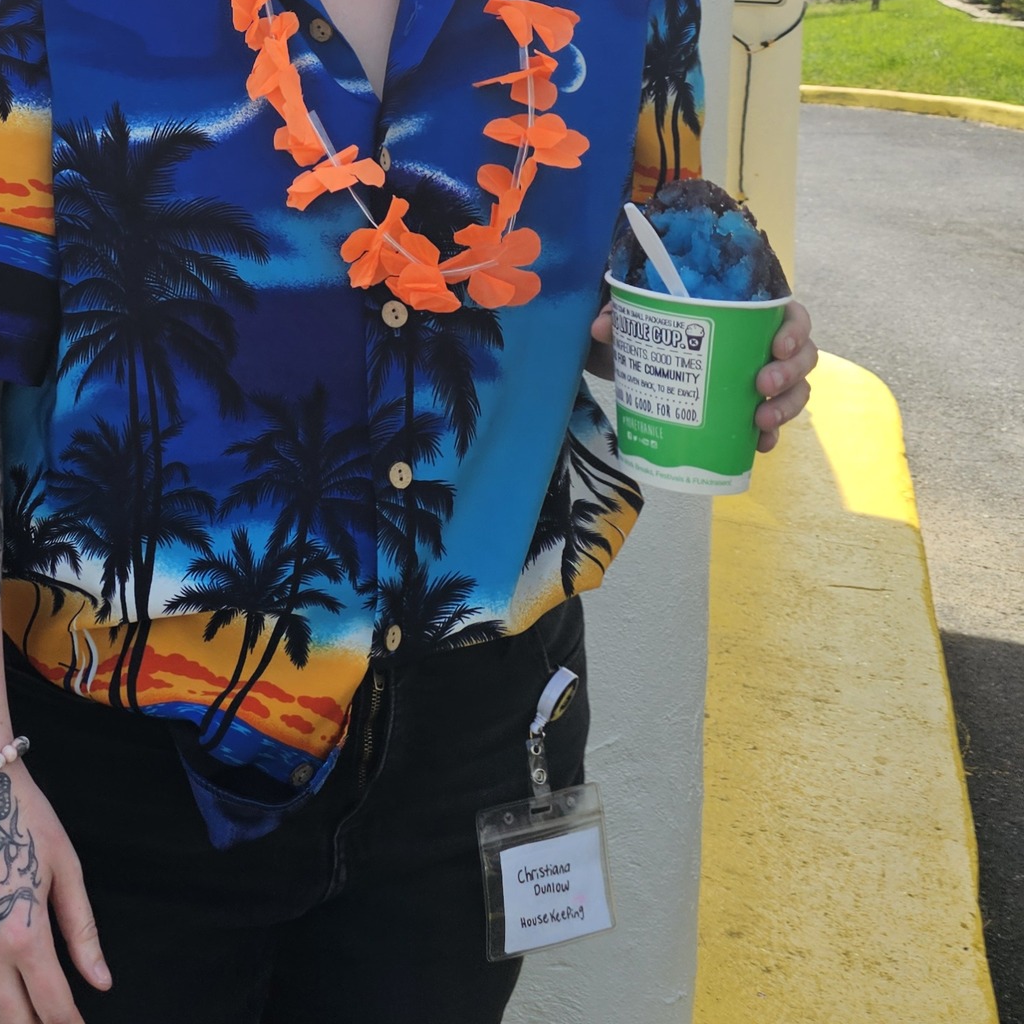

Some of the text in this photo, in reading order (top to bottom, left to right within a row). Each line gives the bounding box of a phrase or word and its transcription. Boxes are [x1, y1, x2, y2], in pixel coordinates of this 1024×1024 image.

[645, 314, 673, 328] PACKAGES
[673, 320, 686, 330] LIKE
[652, 325, 686, 350] CUP.
[629, 358, 642, 373] THE
[645, 364, 701, 384] COMMUNITY
[651, 351, 672, 366] GOOD
[675, 356, 703, 372] TIMES.
[658, 384, 665, 392] TO
[667, 386, 675, 395] BE
[657, 403, 671, 418] FOR
[675, 408, 700, 423] GOOD.
[517, 862, 571, 884] Christiana
